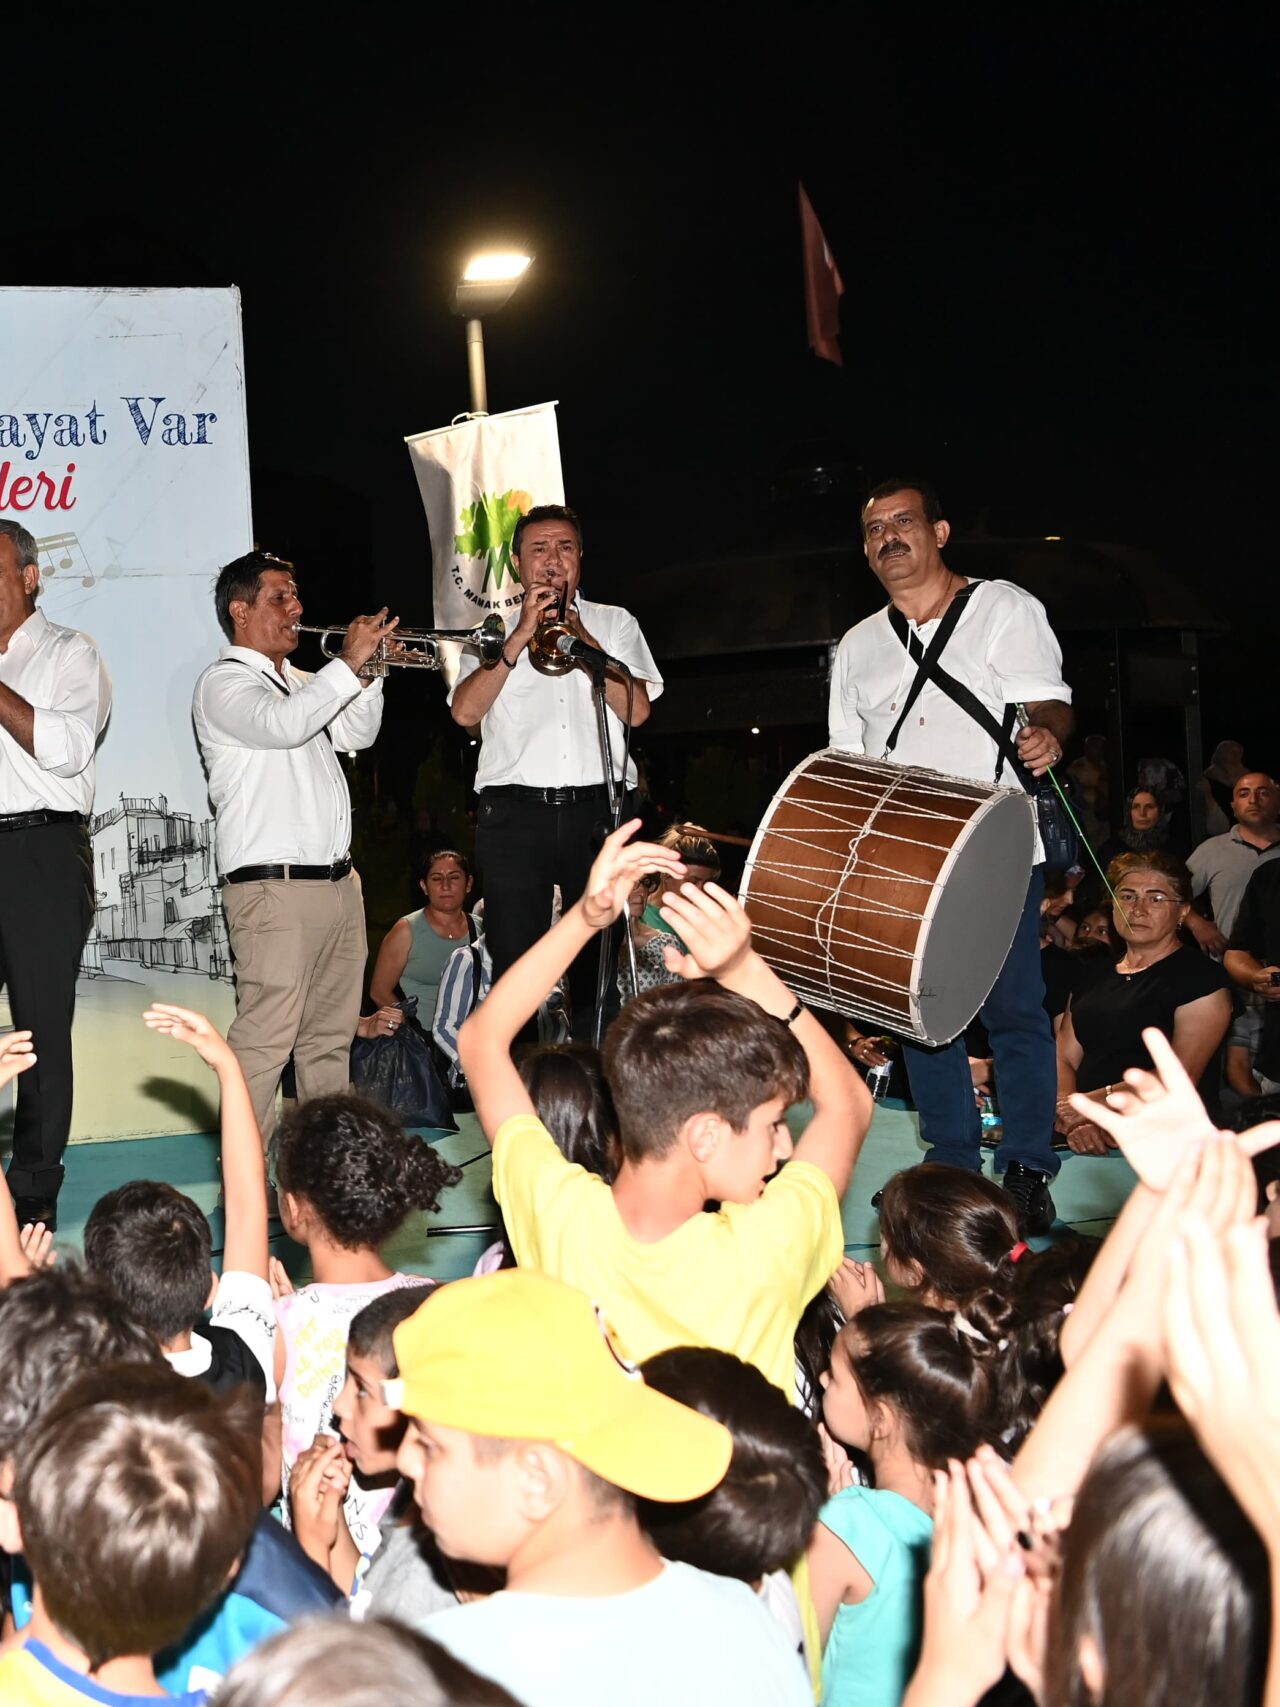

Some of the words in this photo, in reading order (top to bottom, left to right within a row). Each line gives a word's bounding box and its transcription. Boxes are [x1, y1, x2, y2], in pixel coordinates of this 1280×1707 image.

[120, 396, 218, 447] Var
[451, 565, 464, 590] T.C.
[463, 588, 501, 609] MAMAK
